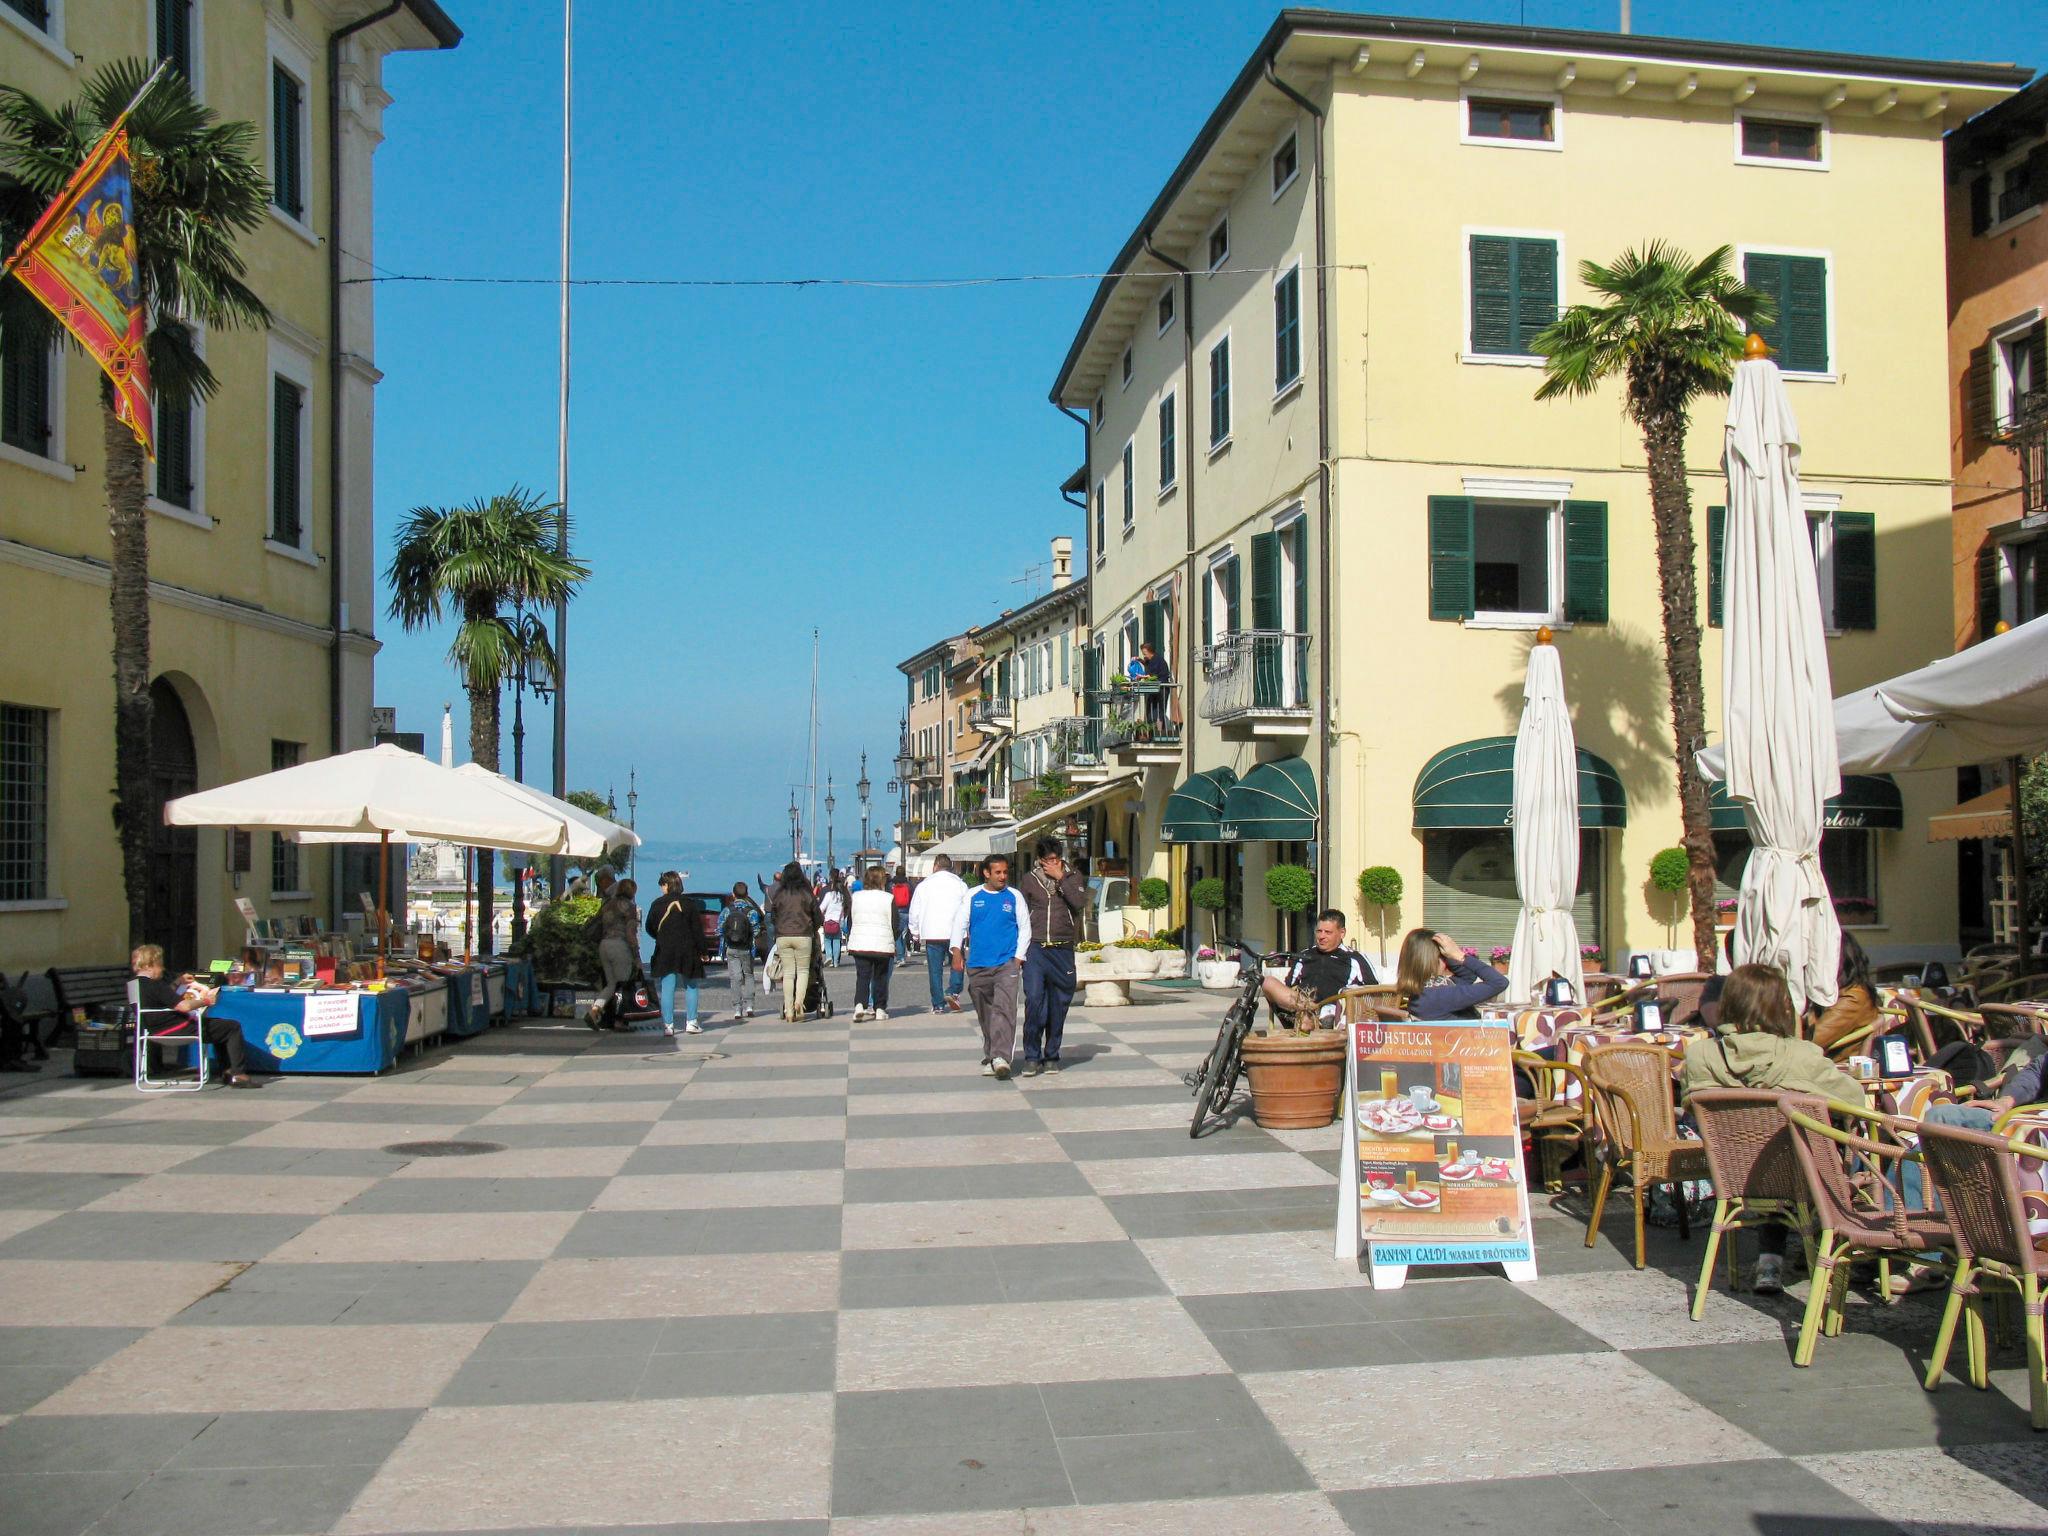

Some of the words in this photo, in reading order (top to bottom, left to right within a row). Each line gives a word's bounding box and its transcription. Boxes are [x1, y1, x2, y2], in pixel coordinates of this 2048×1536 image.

[1375, 1248, 1412, 1262] PANINI
[1416, 1247, 1447, 1261] CALDI
[1449, 1249, 1480, 1260] WARME
